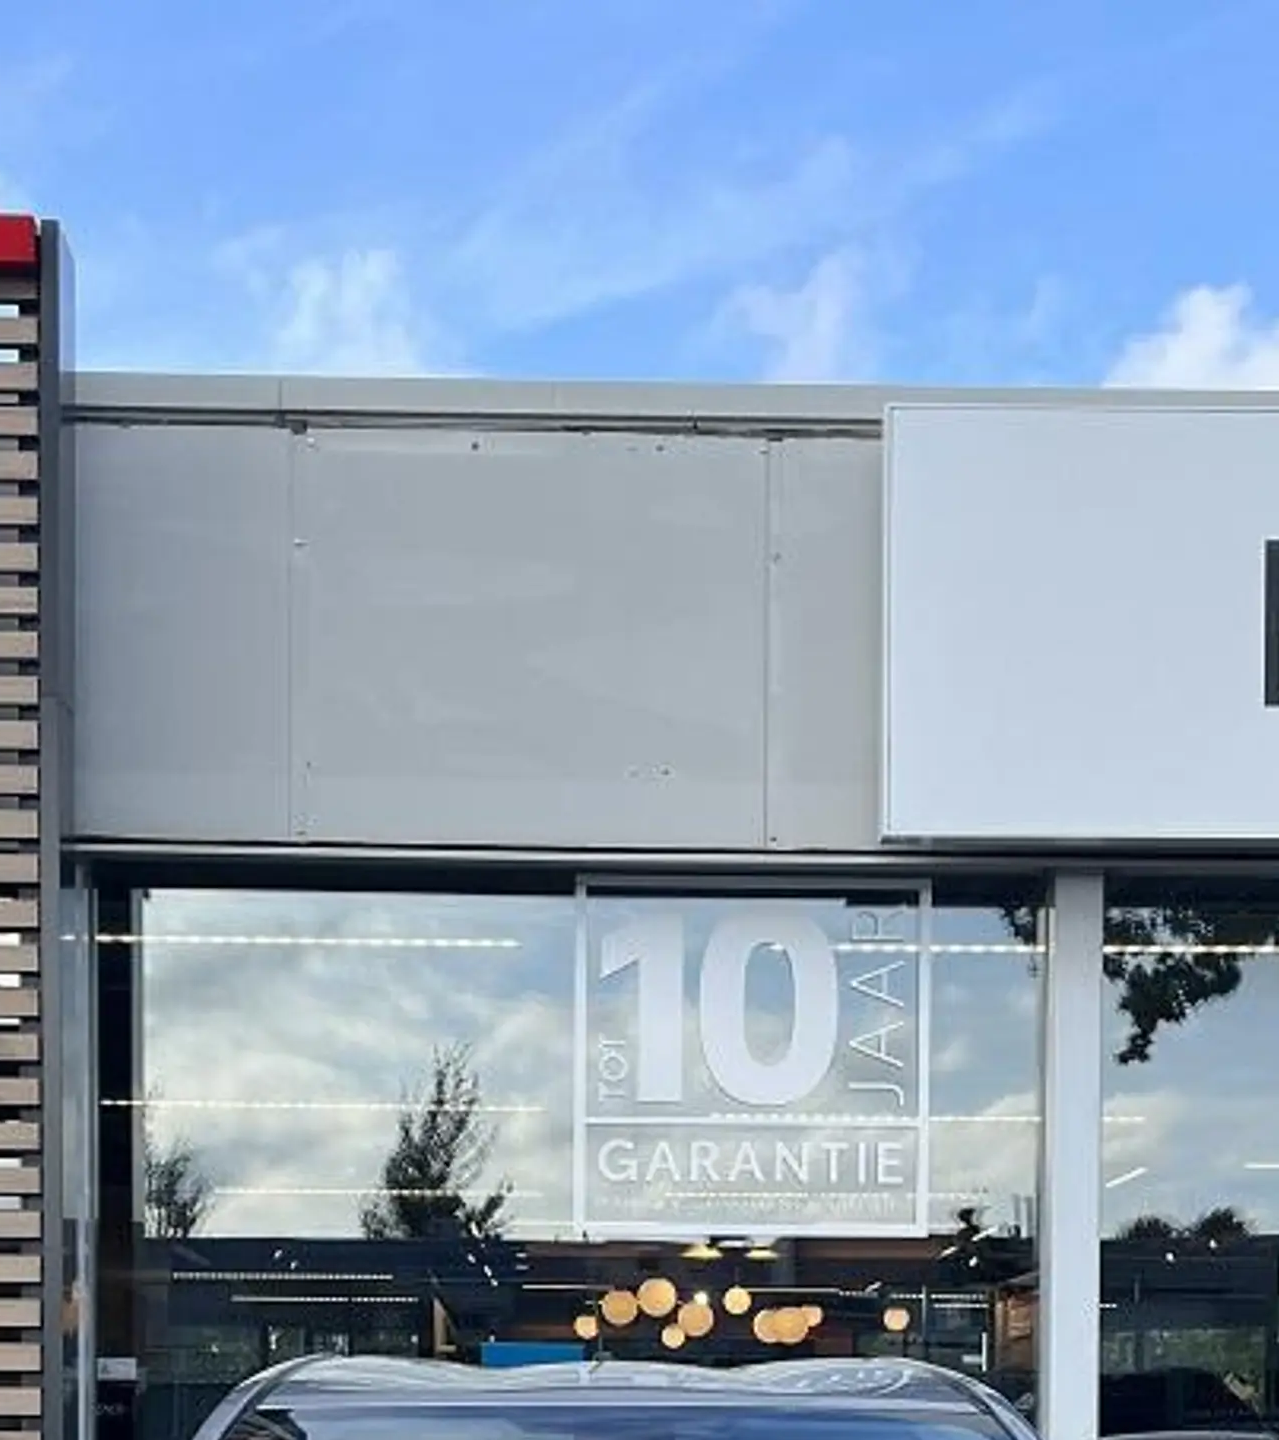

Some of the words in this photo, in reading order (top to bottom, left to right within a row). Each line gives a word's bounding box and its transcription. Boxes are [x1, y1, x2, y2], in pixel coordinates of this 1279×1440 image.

[598, 1035, 628, 1101] TOT
[599, 912, 839, 1106] 10
[847, 910, 907, 1108] JAAR
[597, 1138, 904, 1184] GARANTIE
